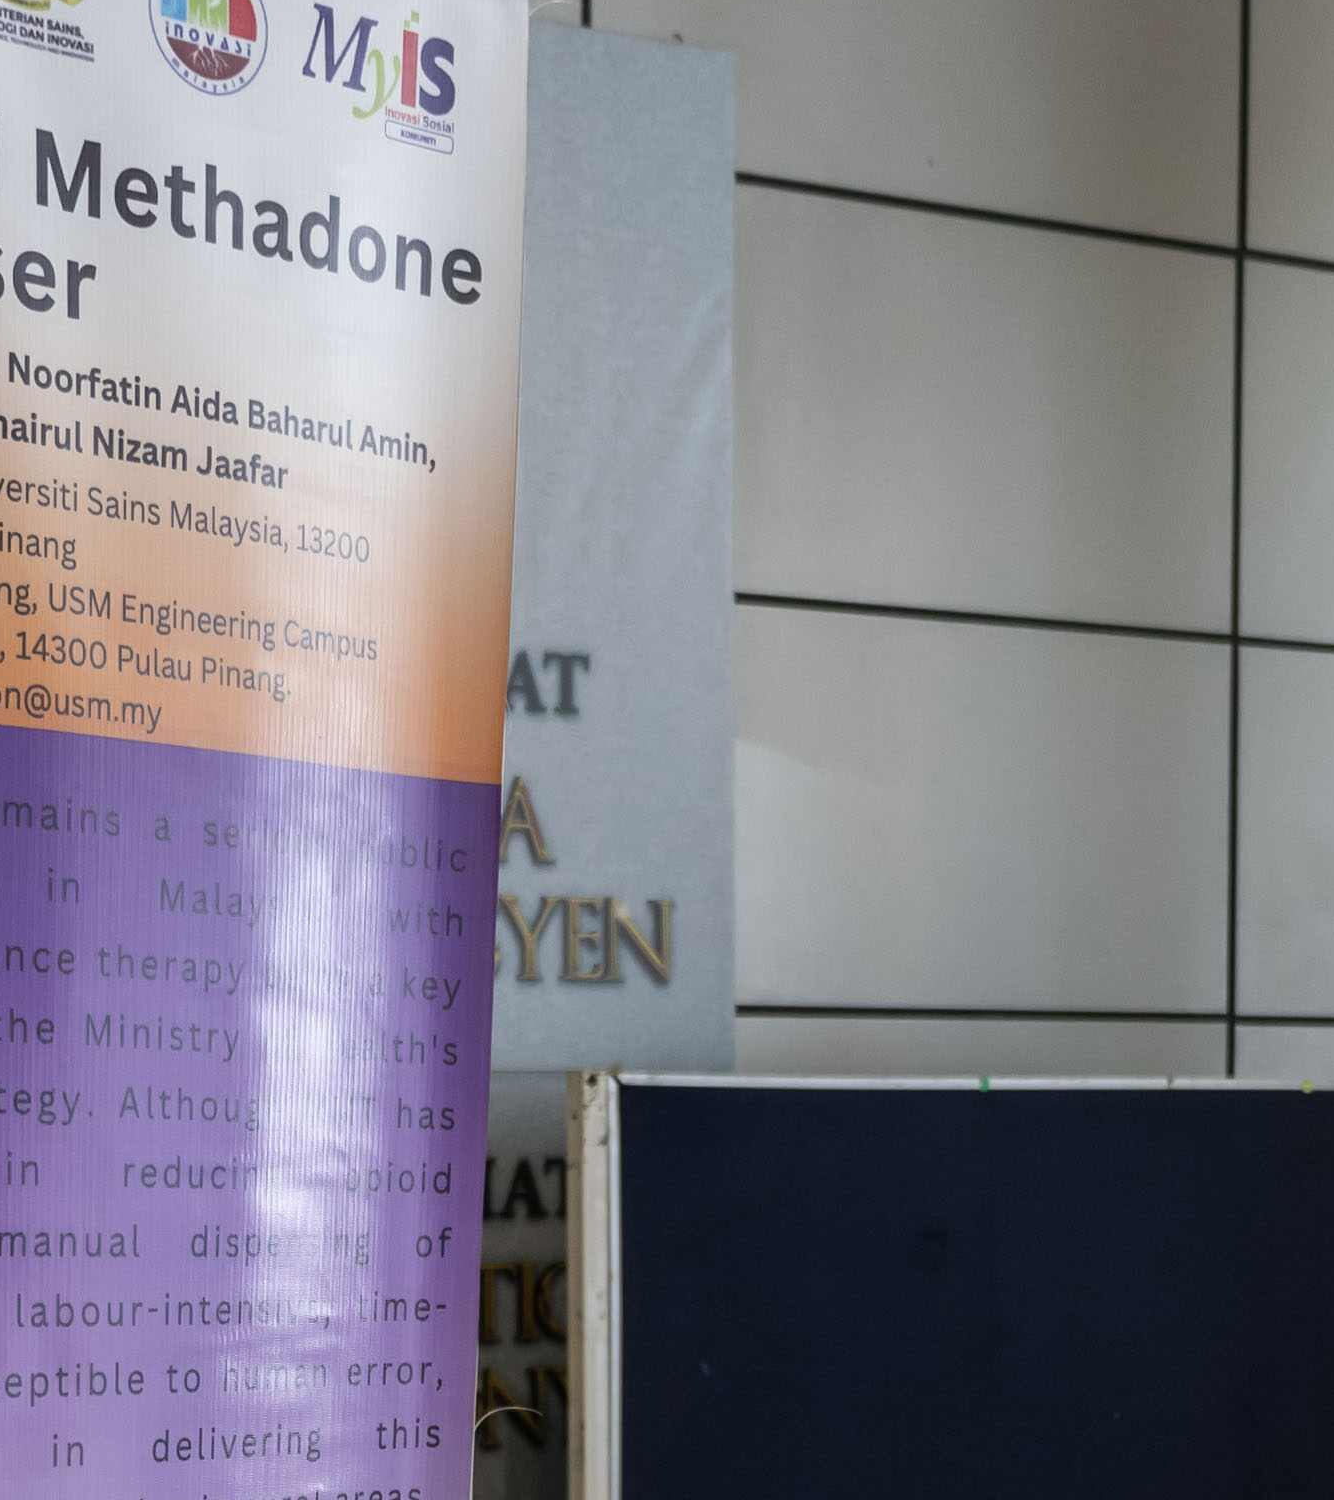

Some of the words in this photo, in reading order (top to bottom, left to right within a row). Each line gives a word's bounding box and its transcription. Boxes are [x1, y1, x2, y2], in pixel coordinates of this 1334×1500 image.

[46, 33, 95, 55] INOVASI
[37, 129, 481, 304] Methadone
[9, 353, 160, 409] Noorfatin
[172, 386, 238, 424] Aida
[249, 400, 351, 448] Baharul
[361, 426, 435, 472] Amin,
[94, 427, 186, 470] Nizam
[197, 447, 287, 488] Jaafar
[88, 488, 160, 525] Sains
[171, 501, 287, 552] Malaysia,
[298, 525, 368, 562] 13200
[167, 1368, 201, 1392] to
[348, 1355, 444, 1391] error,
[53, 1434, 84, 1467] in
[153, 1424, 321, 1464] delivering
[377, 1419, 441, 1450] this
